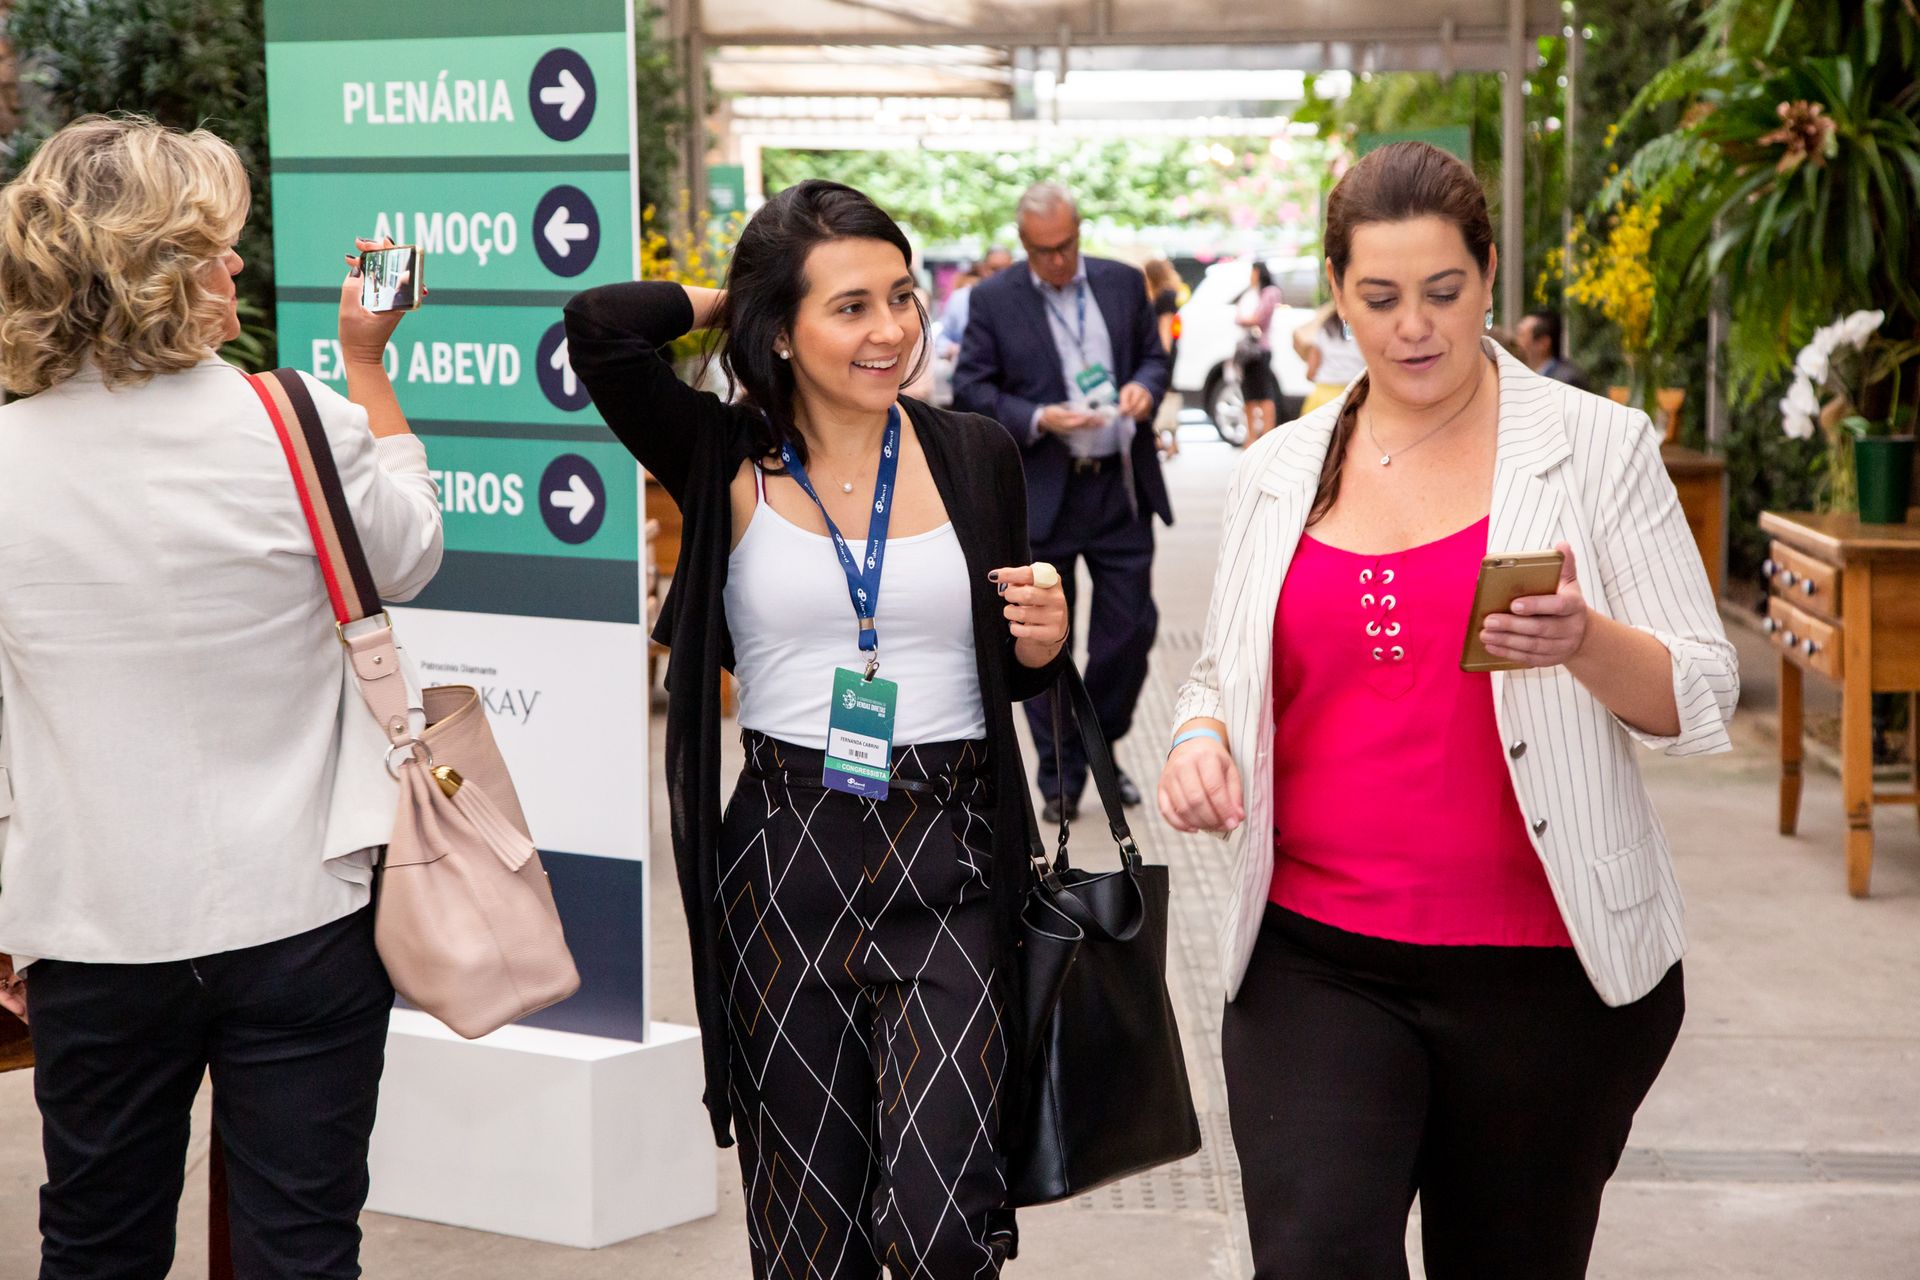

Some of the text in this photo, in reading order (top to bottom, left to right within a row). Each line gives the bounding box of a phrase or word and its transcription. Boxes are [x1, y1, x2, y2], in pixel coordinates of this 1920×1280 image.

[343, 71, 514, 124] PLENÁRIA
[407, 341, 521, 385] ABEVD
[481, 686, 541, 725] KAY
[841, 763, 887, 779] CONGRESSISTA
